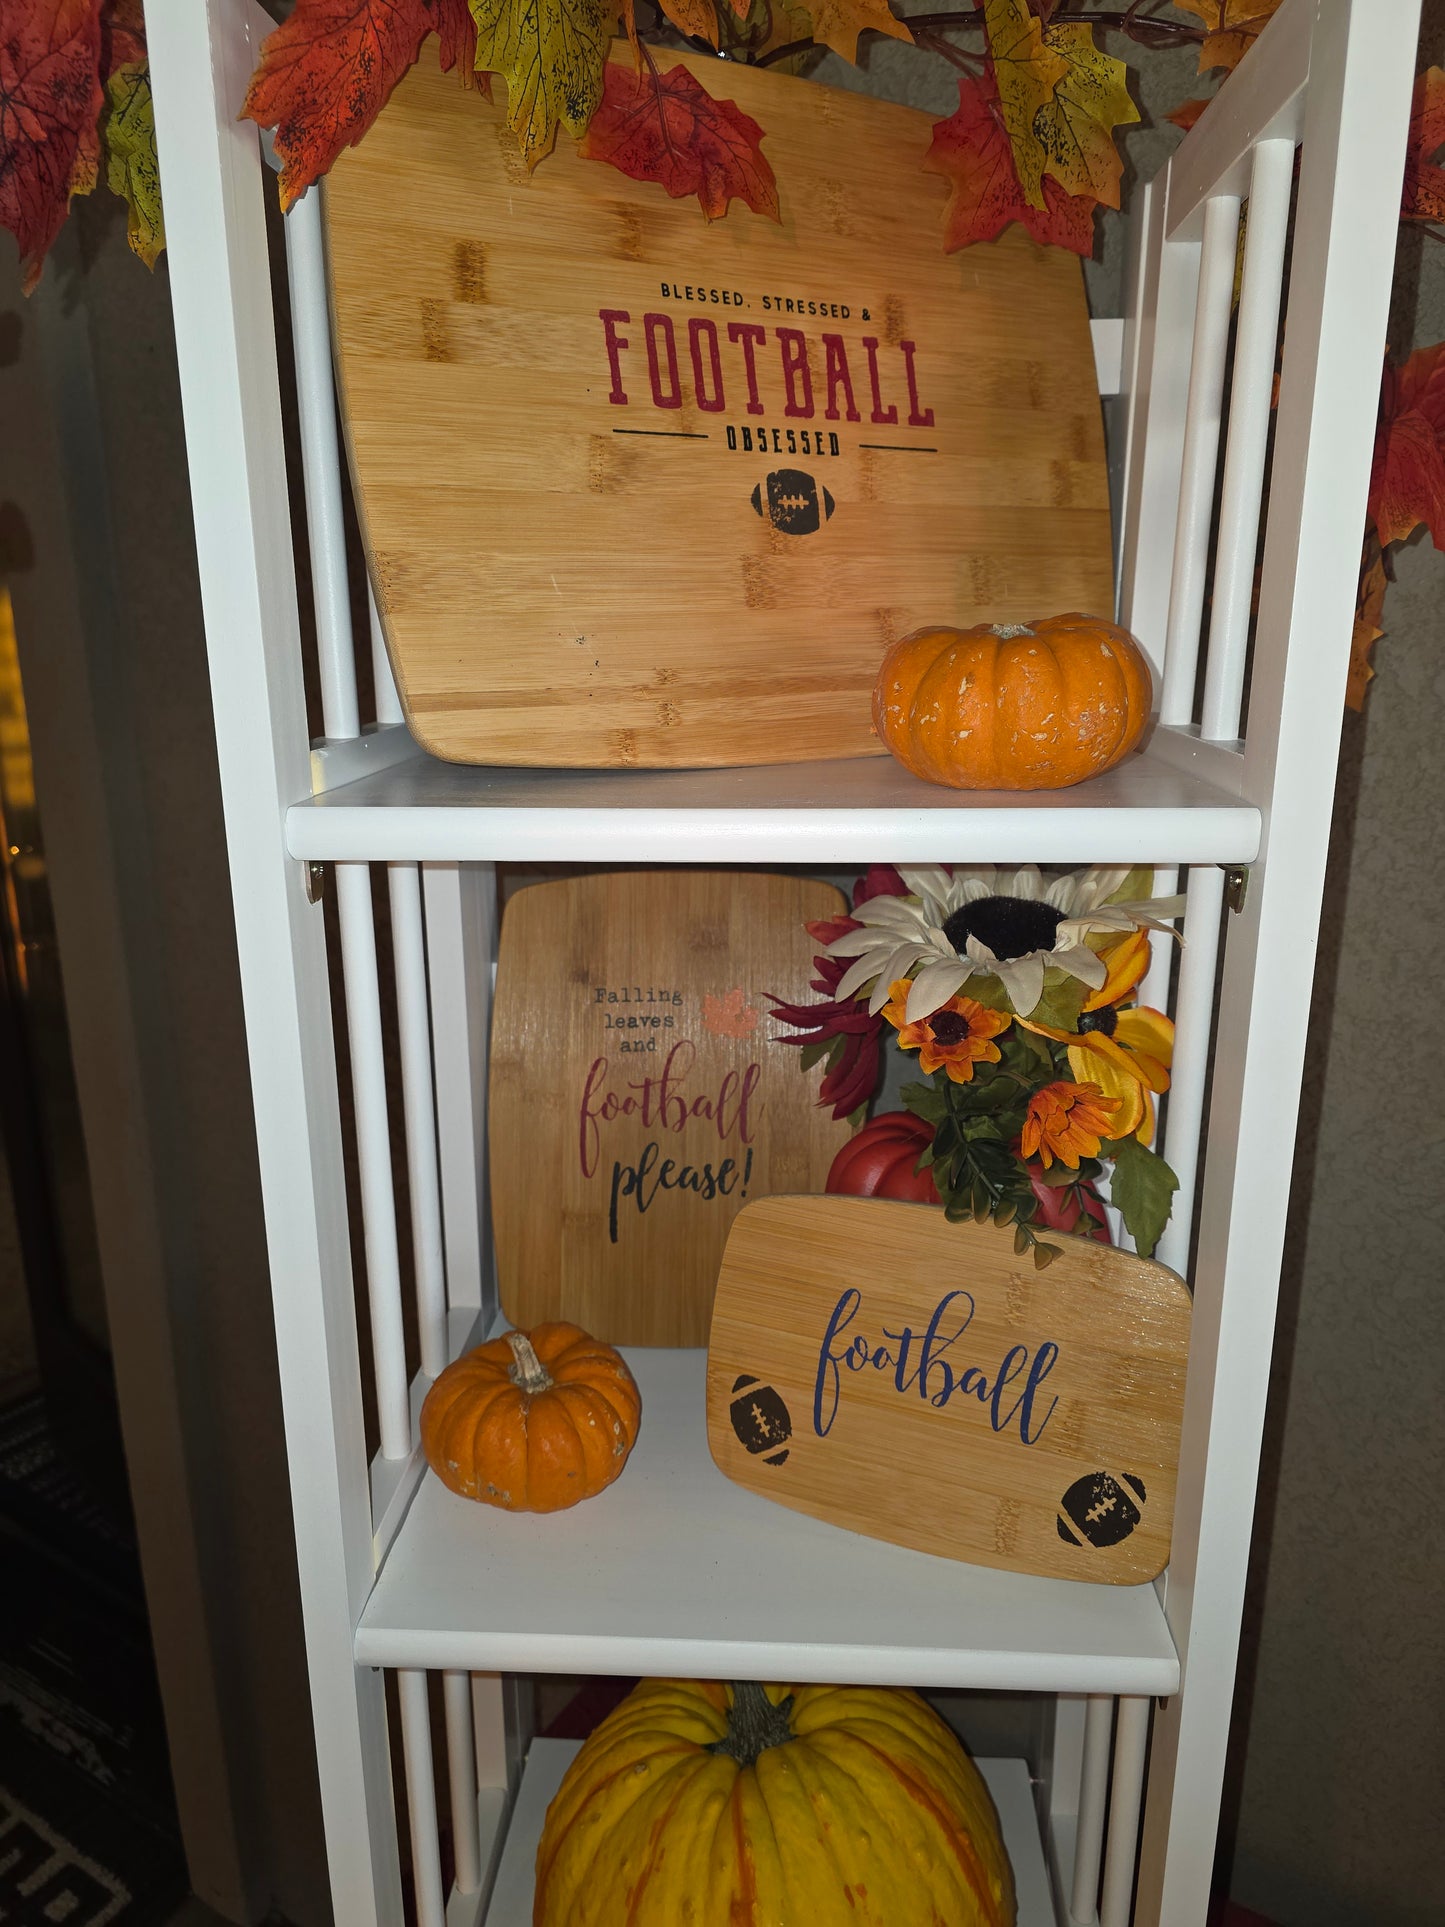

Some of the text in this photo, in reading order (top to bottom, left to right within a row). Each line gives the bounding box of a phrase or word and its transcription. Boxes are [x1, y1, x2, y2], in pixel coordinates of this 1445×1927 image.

[762, 295, 851, 319] STRESSED
[862, 308, 871, 321] &
[599, 309, 935, 427] FOOTBALL
[726, 425, 840, 457] OBSESSED
[594, 987, 684, 1006] Falling
[605, 1014, 675, 1029] leaves
[619, 1037, 657, 1052] and
[579, 1039, 761, 1179] football
[609, 1142, 753, 1244] please!
[813, 1288, 1059, 1445] football
